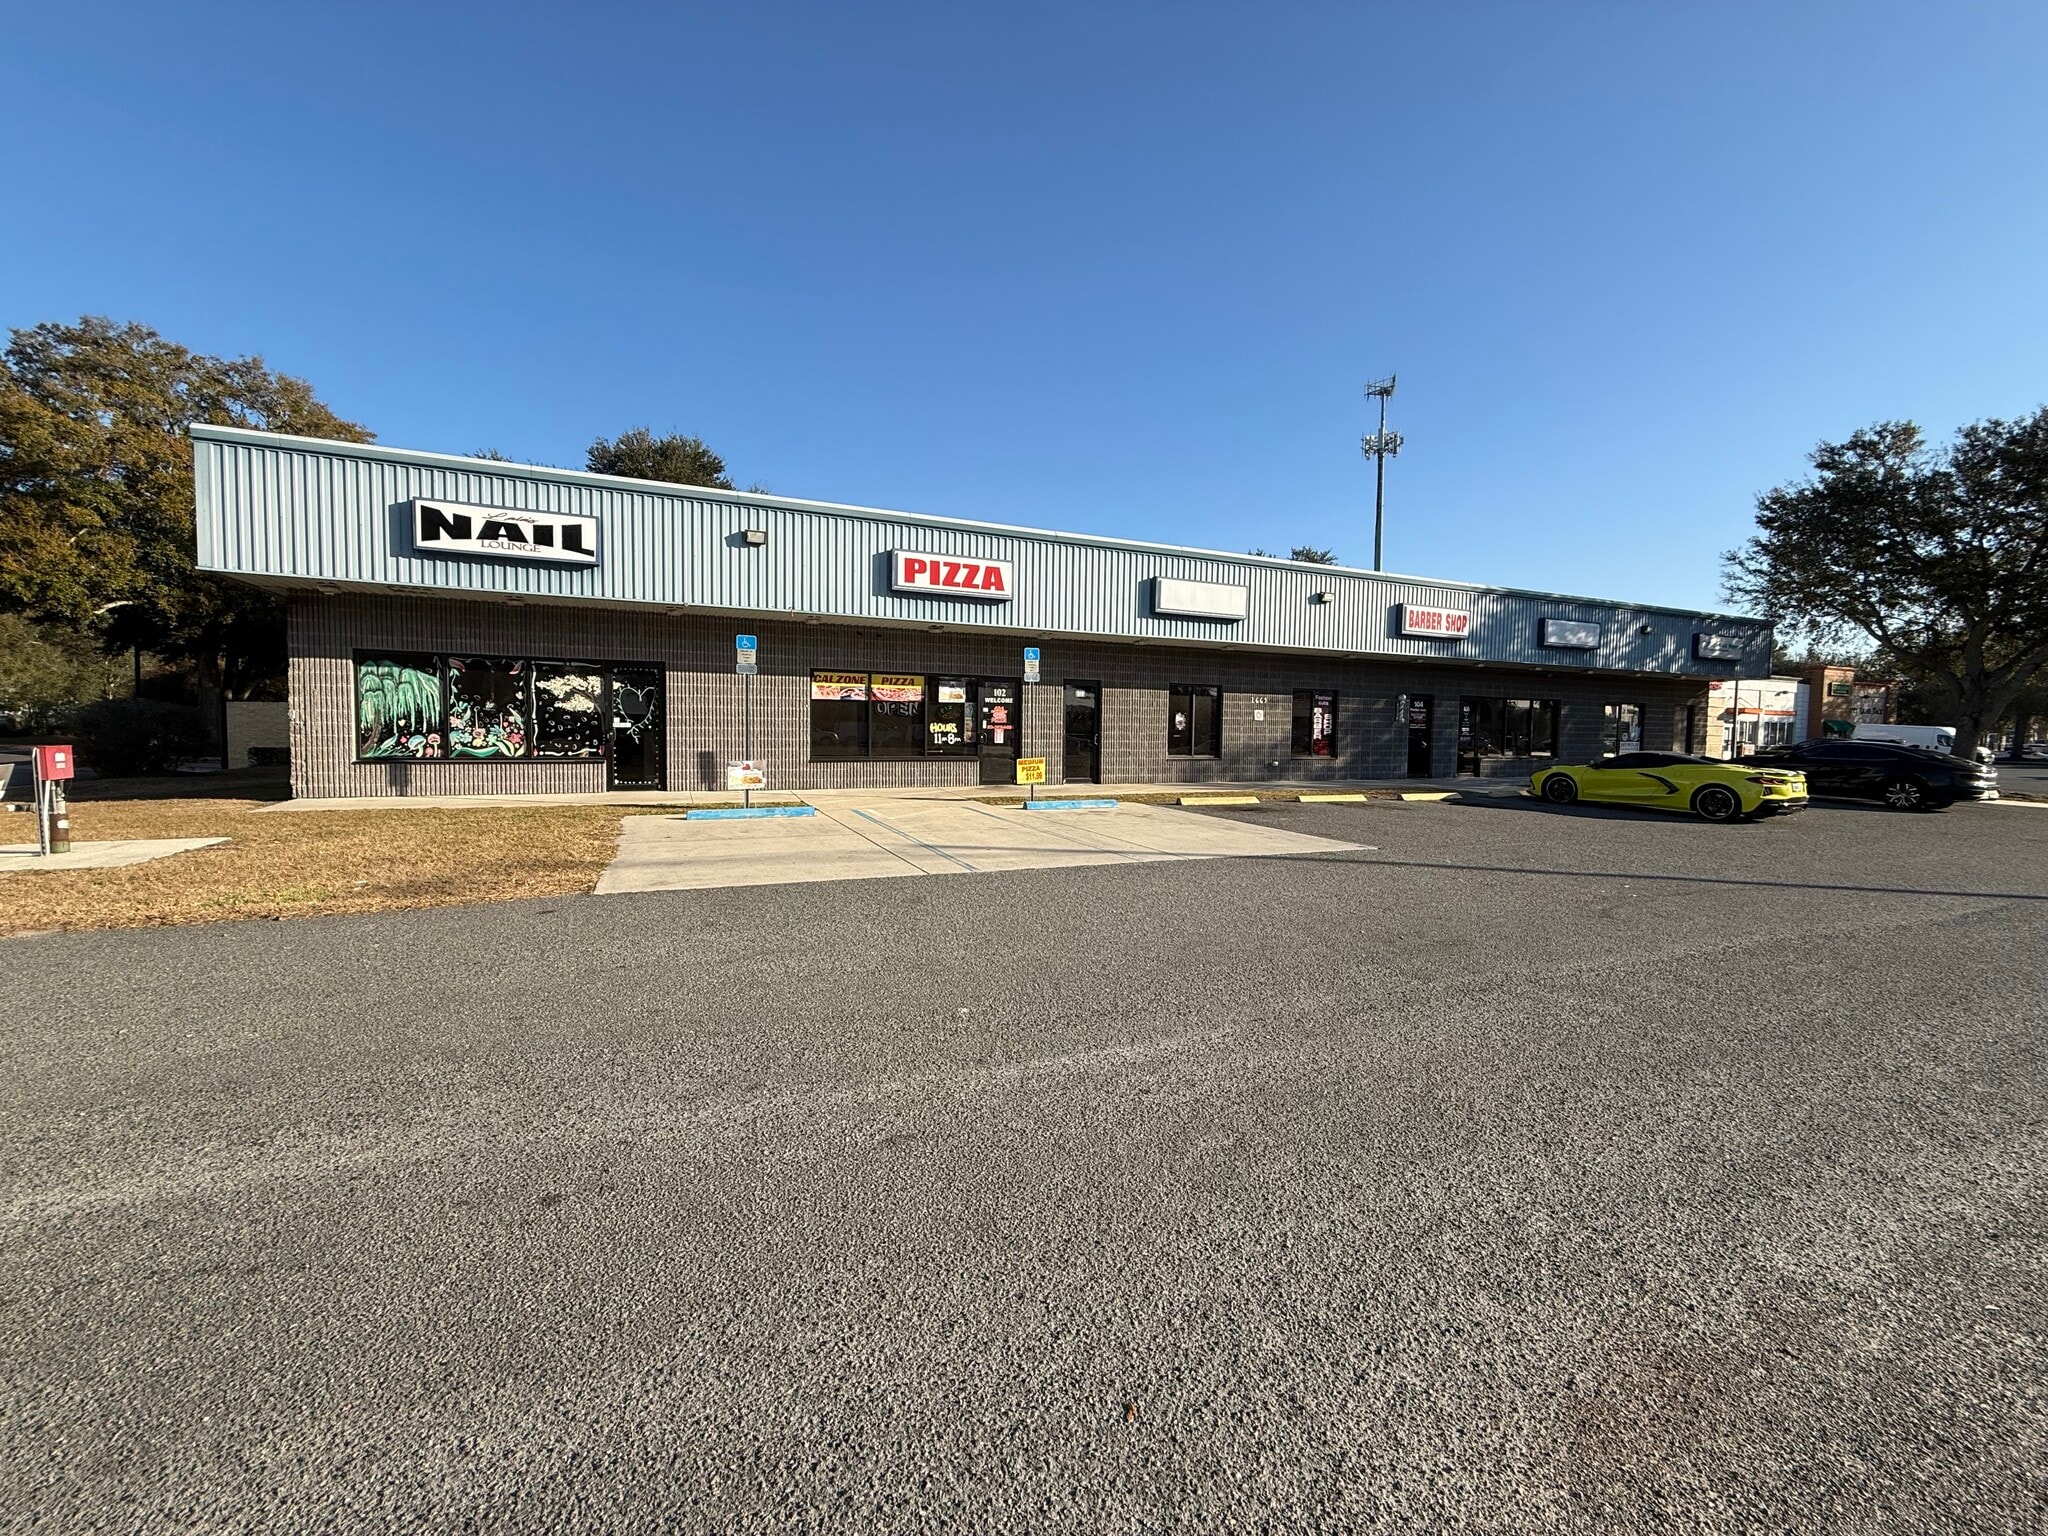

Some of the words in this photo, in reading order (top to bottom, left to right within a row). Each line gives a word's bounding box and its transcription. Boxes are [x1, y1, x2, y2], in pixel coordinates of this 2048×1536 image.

[420, 504, 595, 557] NAIL
[481, 539, 541, 553] LOUNGE
[904, 557, 1005, 592] PIZZA
[1408, 609, 1442, 631] BARBER
[1445, 613, 1467, 633] SHOP
[813, 674, 866, 684] CALZONE
[881, 677, 915, 686] PIZZA
[993, 688, 1006, 697] 102
[875, 701, 920, 717] OPEN
[1323, 713, 1332, 736] SHOP
